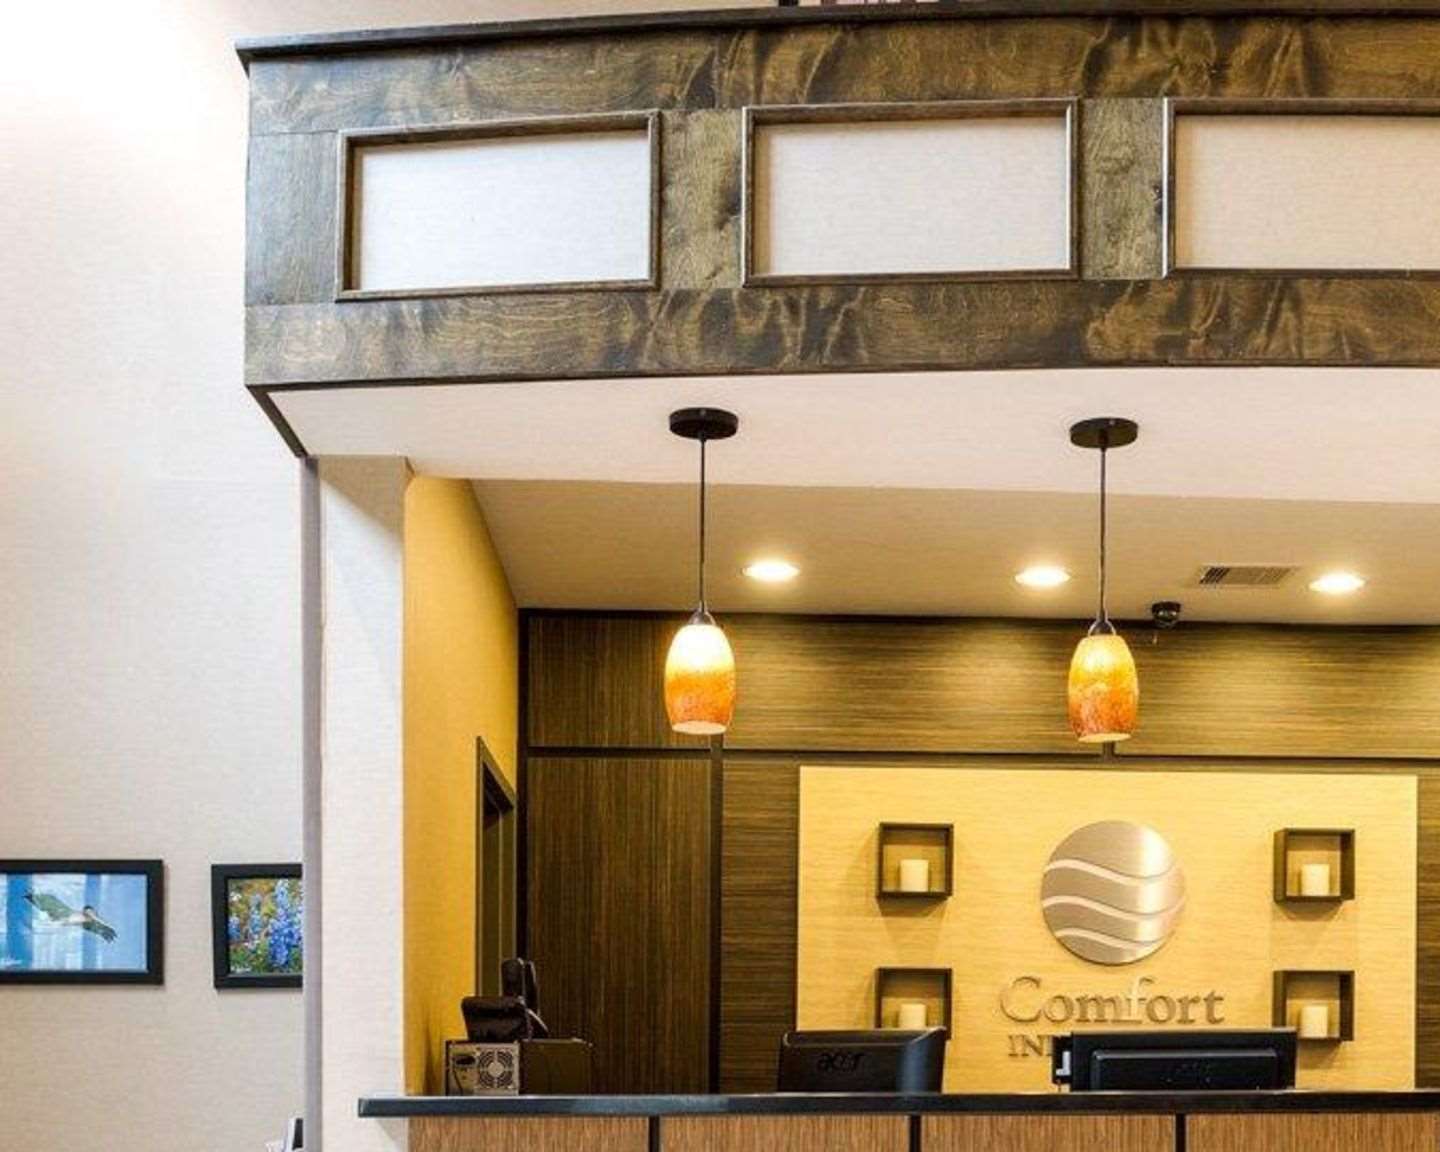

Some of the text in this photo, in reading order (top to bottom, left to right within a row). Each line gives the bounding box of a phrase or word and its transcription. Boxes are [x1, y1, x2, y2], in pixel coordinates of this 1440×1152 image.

[1000, 975, 1225, 1025] Comfort
[1008, 1034, 1053, 1057] IN
[815, 1052, 864, 1073] acer
